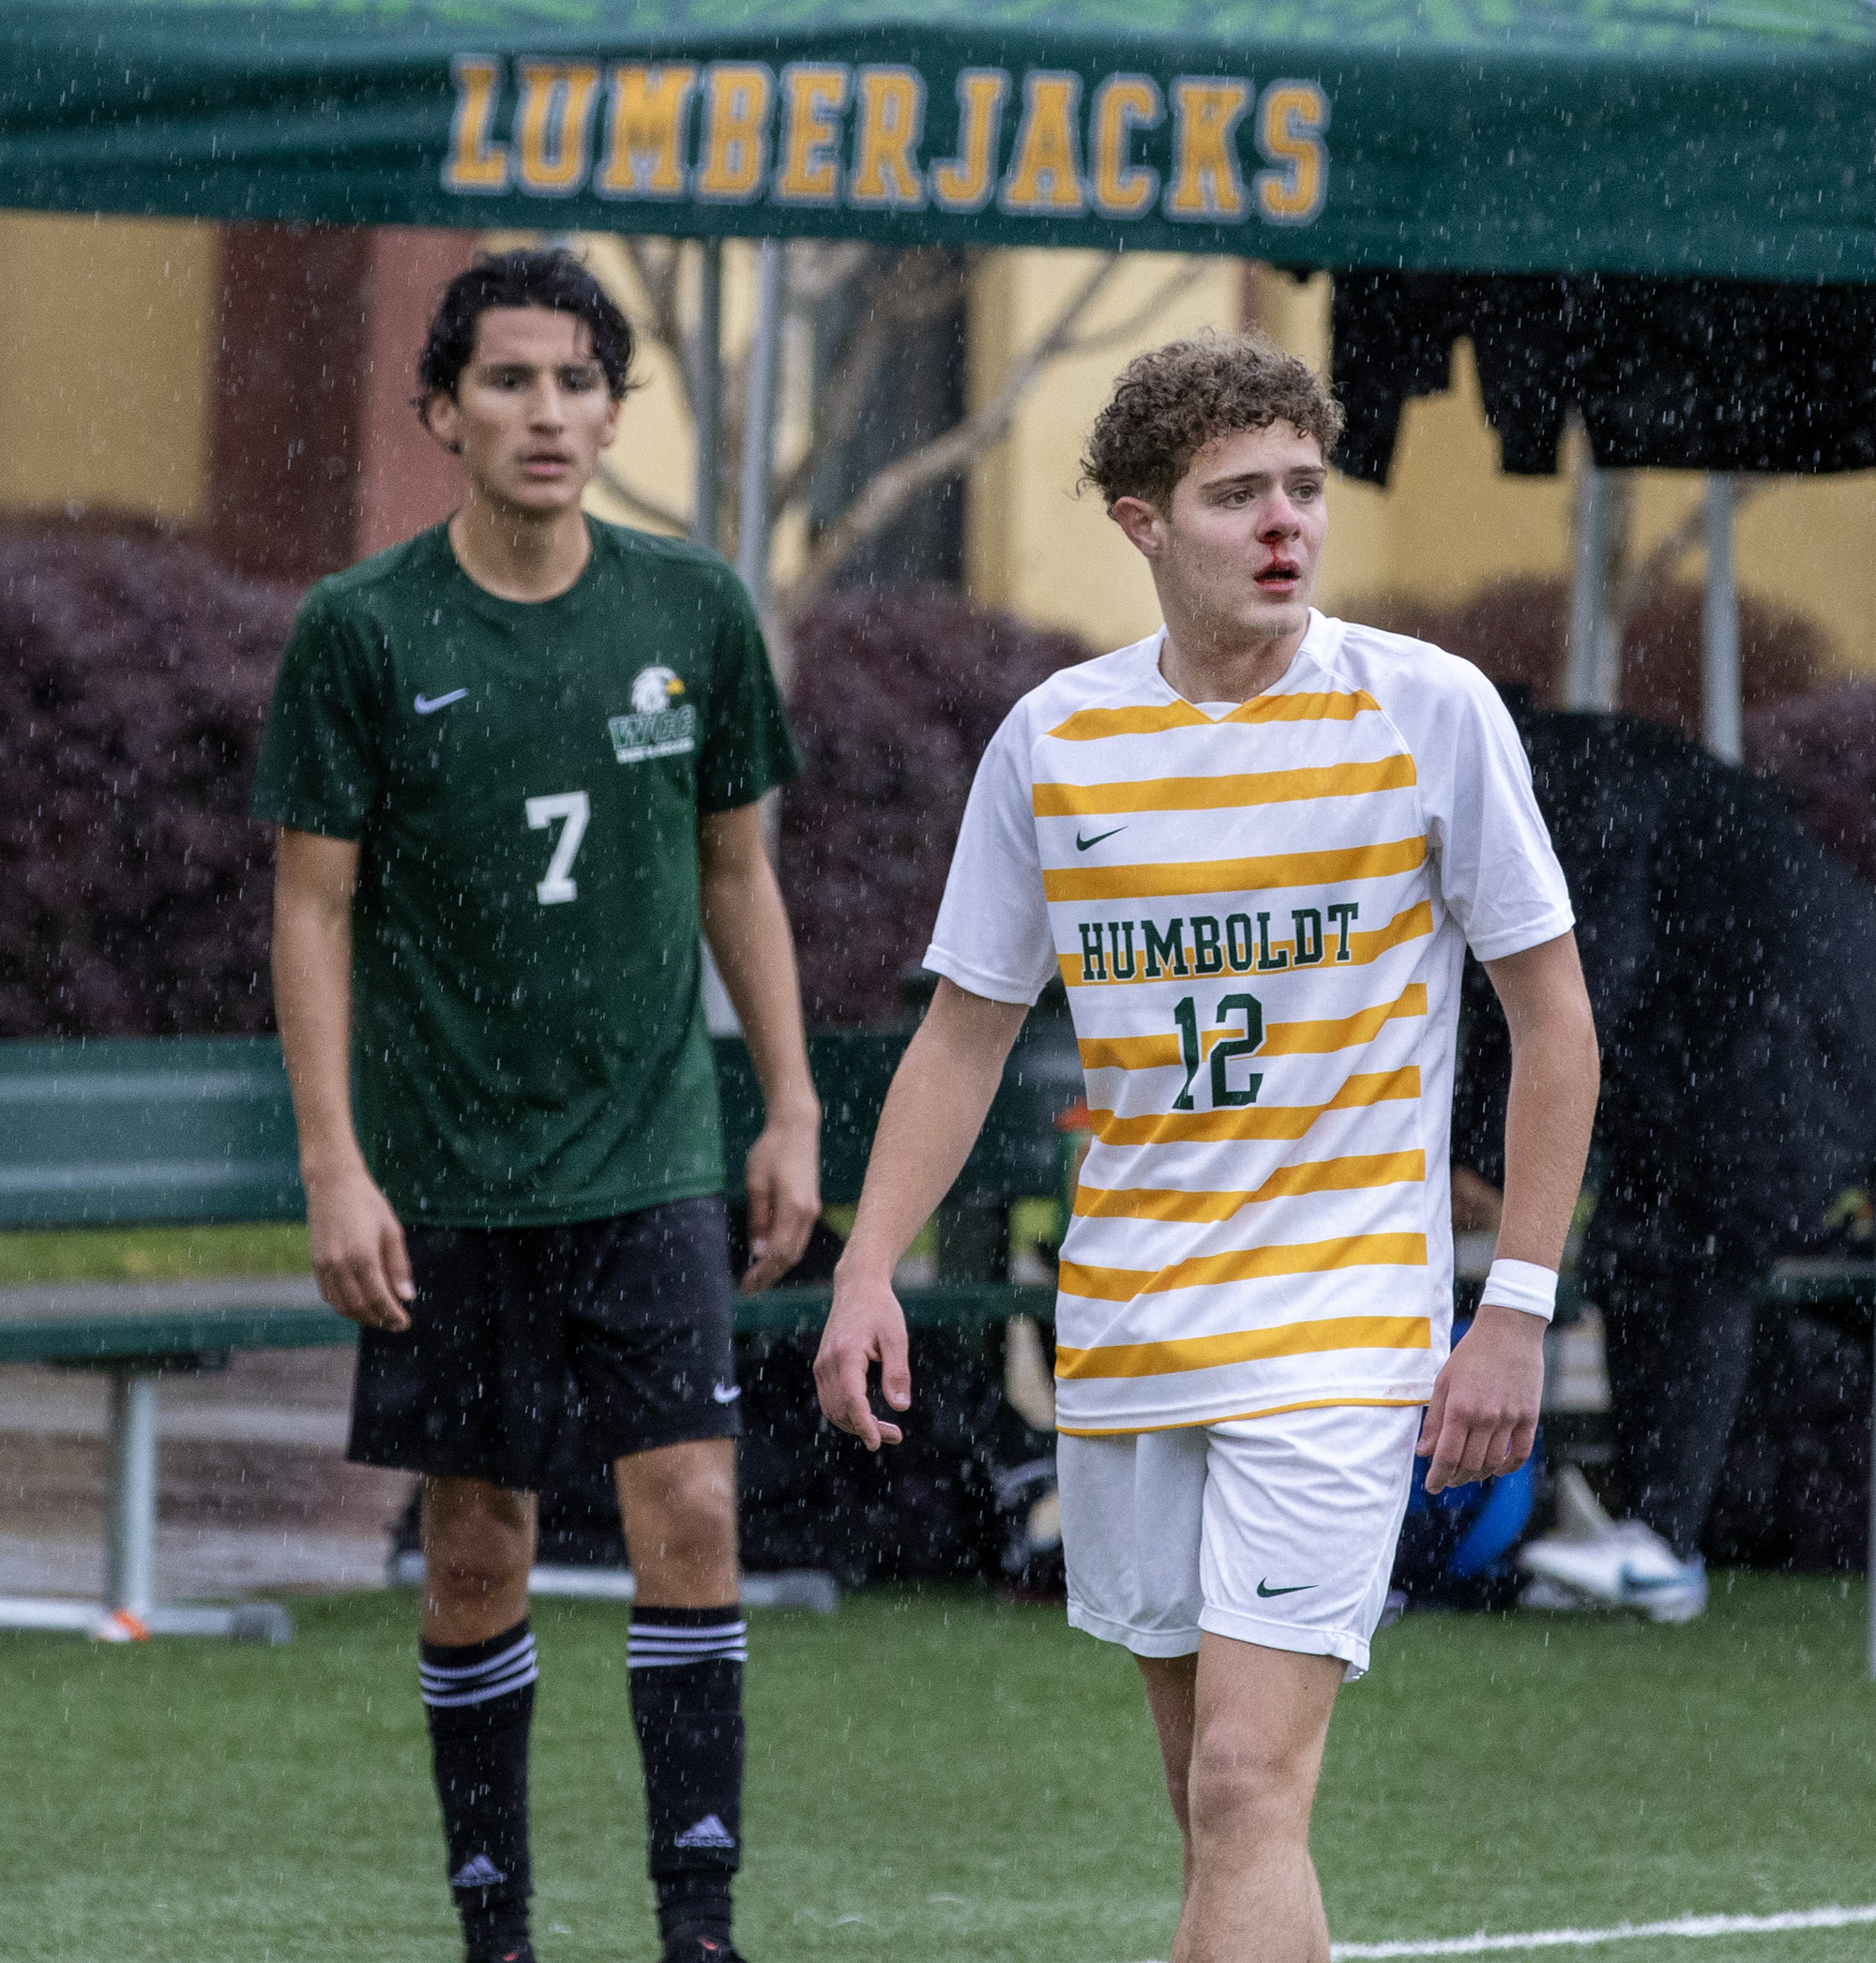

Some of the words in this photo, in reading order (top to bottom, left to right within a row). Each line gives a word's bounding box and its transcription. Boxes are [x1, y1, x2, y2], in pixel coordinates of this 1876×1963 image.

[444, 54, 1329, 223] LUMBERJACKS
[525, 791, 590, 905] 7
[1079, 902, 1359, 981] HUMBOLDT
[1172, 992, 1264, 1110] 12
